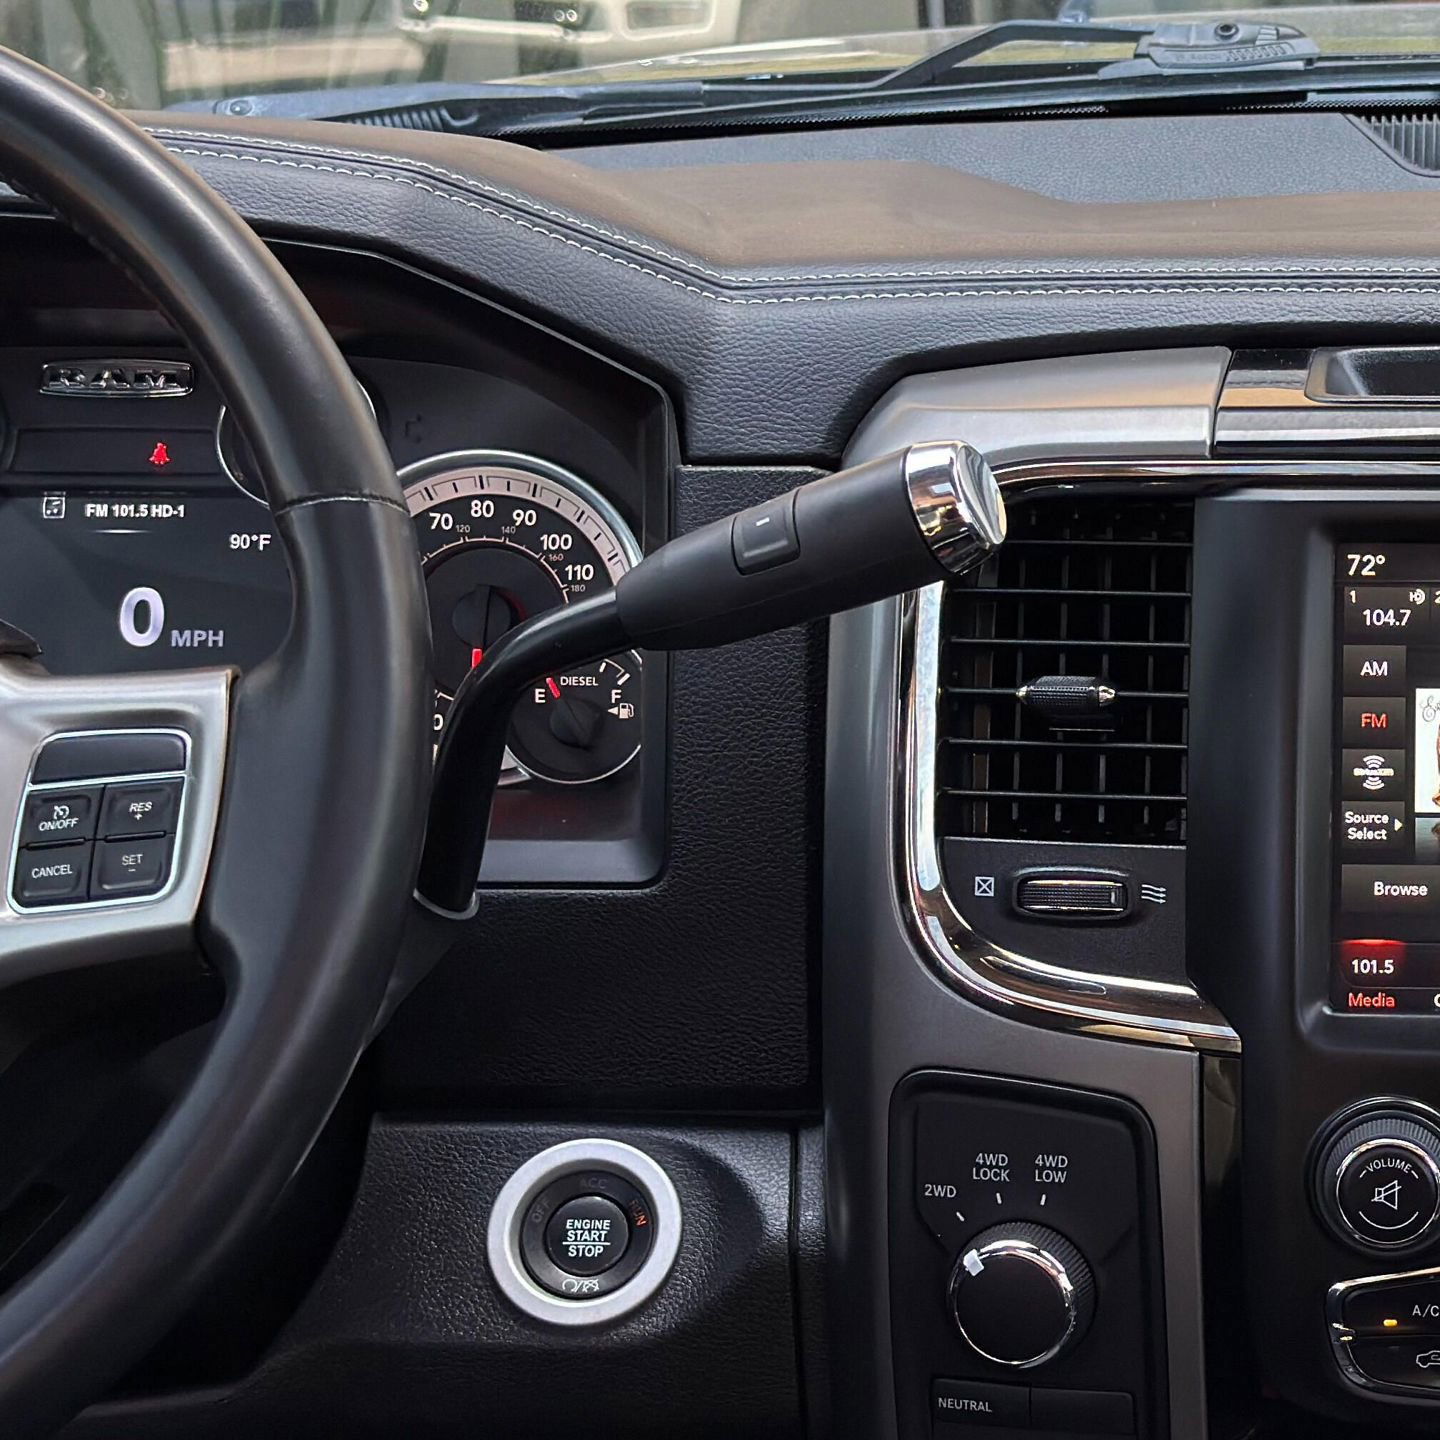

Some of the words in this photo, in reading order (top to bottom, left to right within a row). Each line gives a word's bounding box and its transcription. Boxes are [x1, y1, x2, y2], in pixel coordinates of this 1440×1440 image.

[84, 504, 109, 519] FM
[111, 504, 149, 519] 101.5
[150, 504, 186, 519] HD-1
[469, 499, 495, 519] 80
[428, 512, 454, 531] 70
[511, 509, 538, 527] 90
[455, 524, 471, 534] 120
[500, 525, 517, 535] 140
[229, 534, 272, 551] 90°F
[539, 533, 573, 552] 100
[548, 552, 565, 563] 160
[1347, 554, 1386, 577] 72°
[564, 563, 595, 582] 110
[570, 583, 587, 593] 180
[1349, 590, 1357, 604] 1
[118, 586, 165, 649] 0
[170, 629, 225, 649] MPH
[1361, 609, 1412, 627] 104.7
[1359, 660, 1389, 677] AM
[559, 675, 599, 688] DIESEL
[534, 688, 547, 704] E
[610, 688, 623, 704] F
[1360, 713, 1389, 729] FM
[128, 801, 154, 814] RES
[38, 816, 80, 833] ON/OFF
[1344, 811, 1390, 825] Source
[1346, 827, 1388, 841] Select
[121, 853, 144, 867] SET
[31, 863, 73, 880] CANCEL
[1373, 880, 1429, 897] Browse
[1350, 958, 1395, 975] 101.5
[1347, 992, 1396, 1009] Media
[974, 1152, 1009, 1167] 4WD
[1034, 1153, 1069, 1169] 4WD
[1365, 1158, 1412, 1174] VOLUME
[972, 1167, 1011, 1183] LOCK
[1034, 1168, 1068, 1184] LOW
[923, 1183, 958, 1199] 2WD
[565, 1218, 612, 1231] ENGINE
[566, 1229, 608, 1242] START
[567, 1244, 605, 1258] STOP
[1411, 1304, 1440, 1318] A/C
[937, 1396, 994, 1415] NEUTRAL
